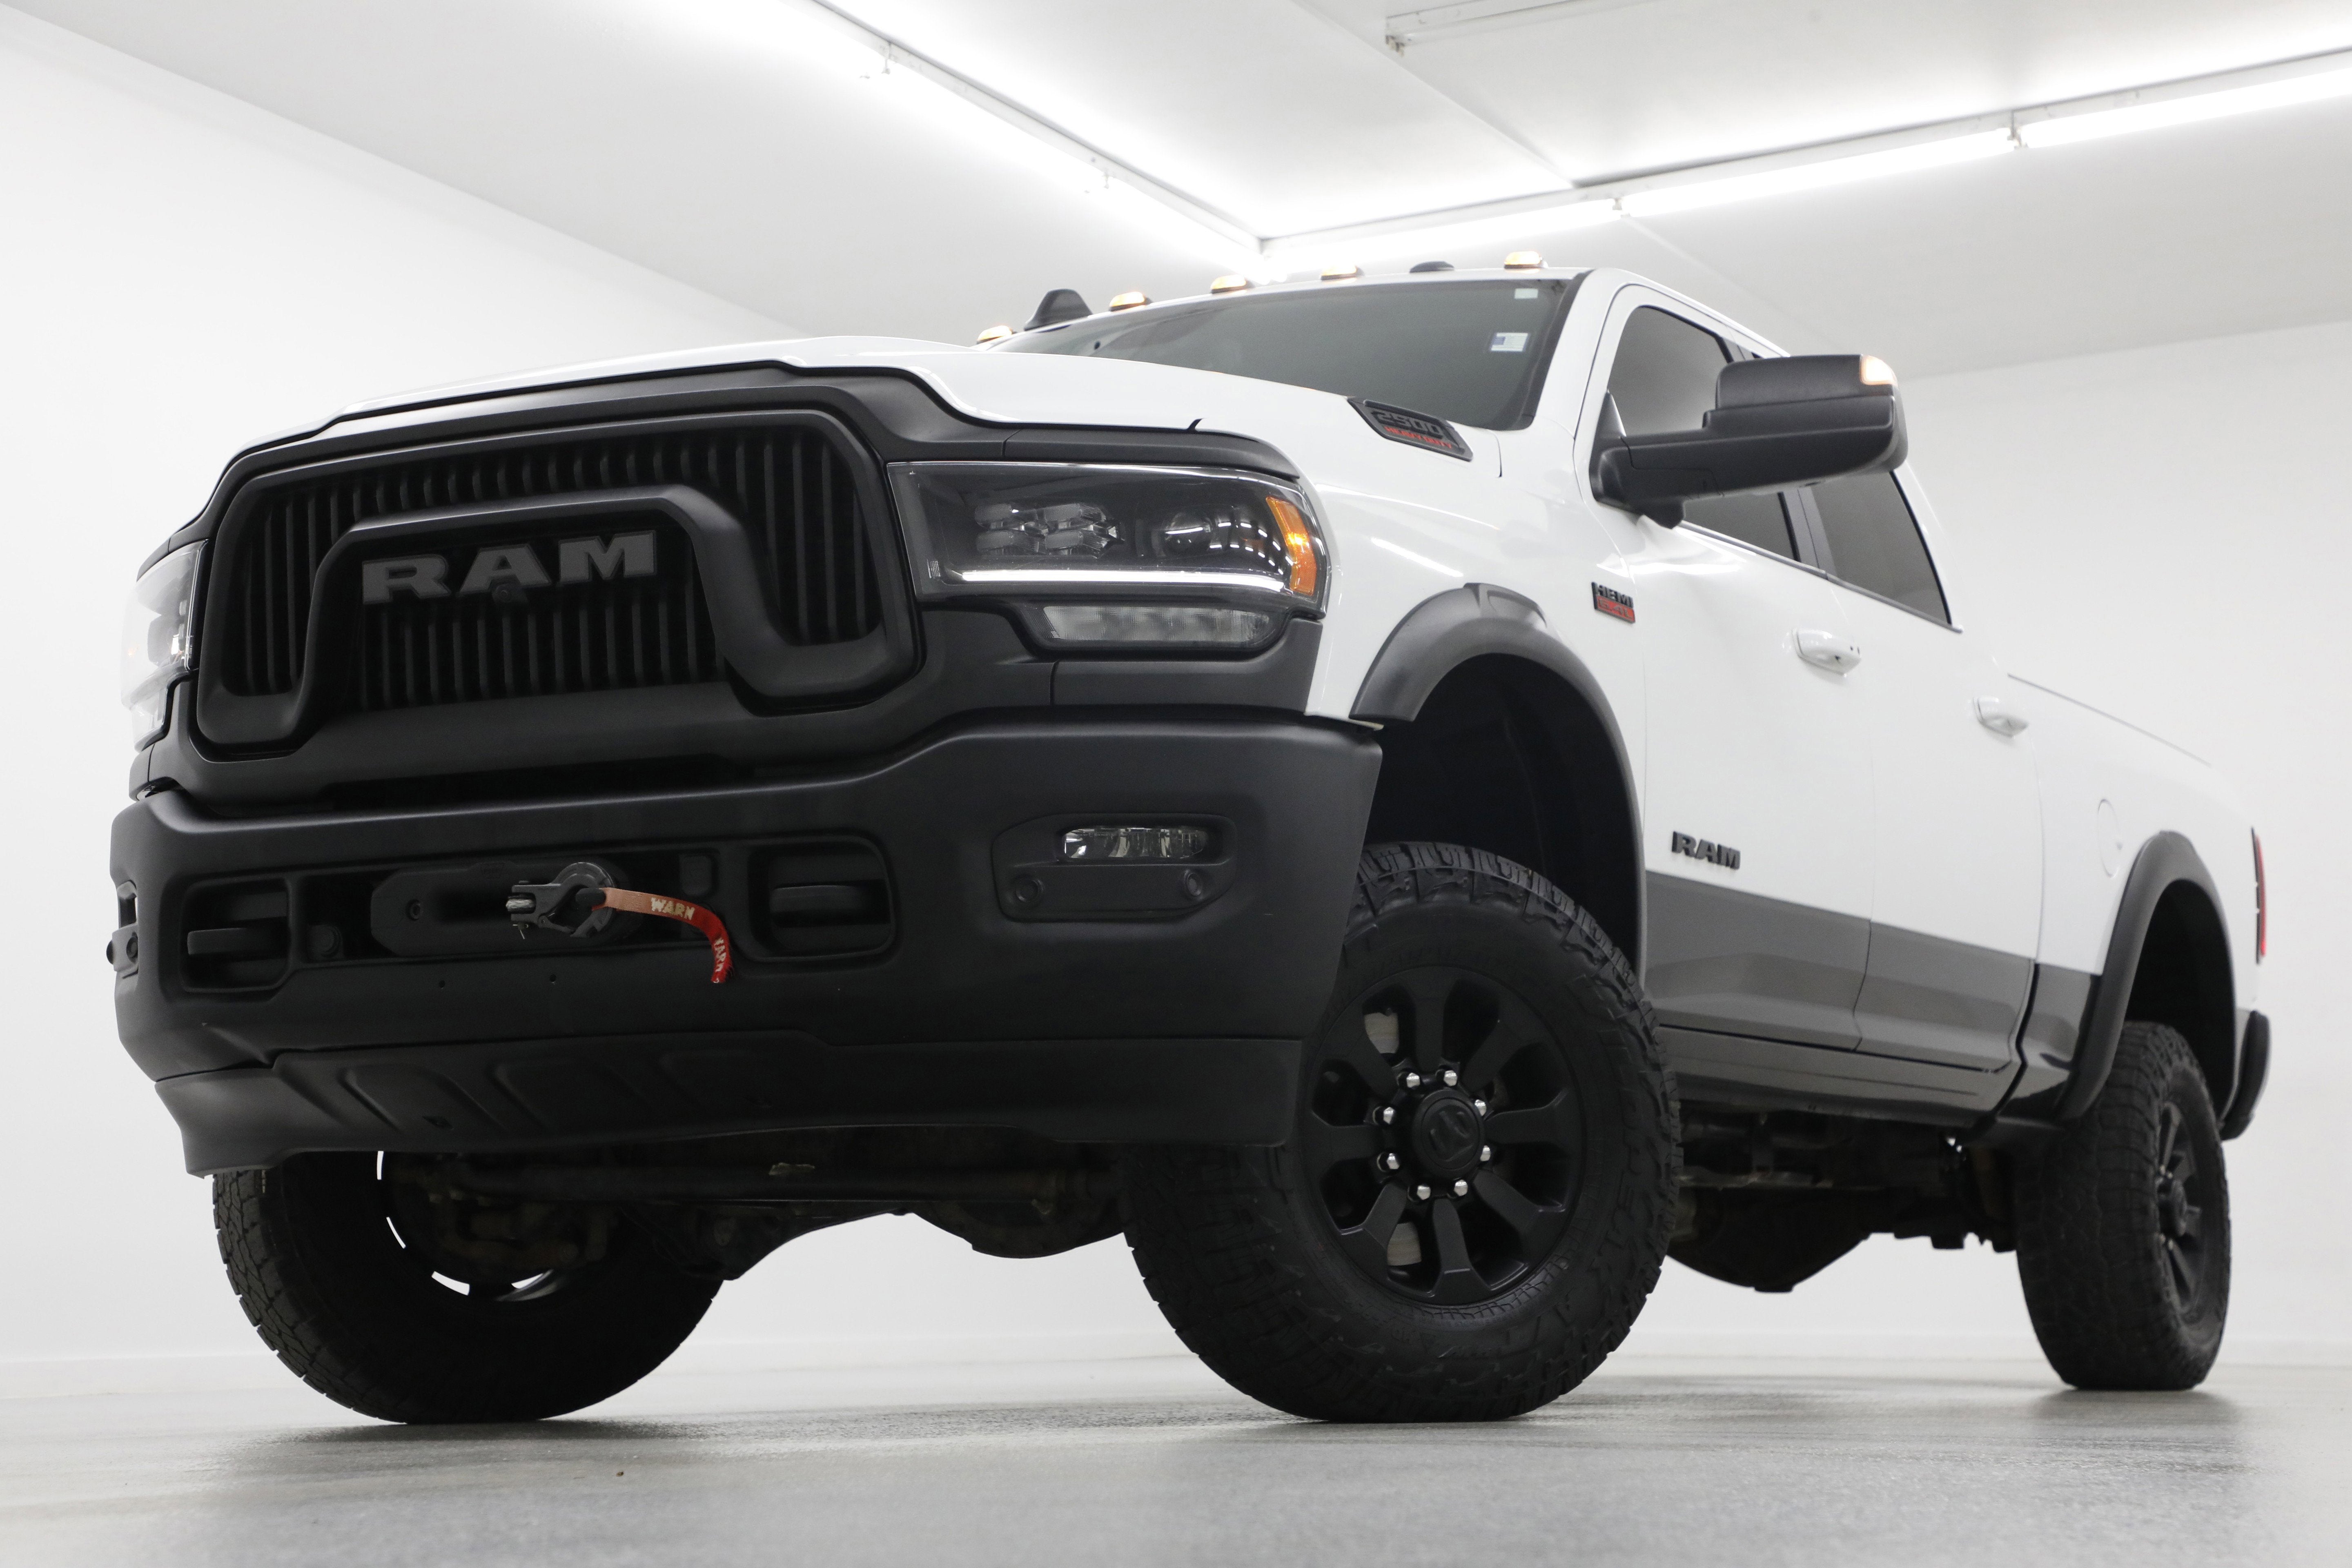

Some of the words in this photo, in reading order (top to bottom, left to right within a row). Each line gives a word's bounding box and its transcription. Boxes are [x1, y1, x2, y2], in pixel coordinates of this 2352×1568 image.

[1371, 410, 1444, 439] 2500
[362, 530, 656, 605] RAM
[1591, 581, 1633, 608] HEMI
[1672, 831, 1741, 870] RAM
[651, 897, 695, 920] WARN
